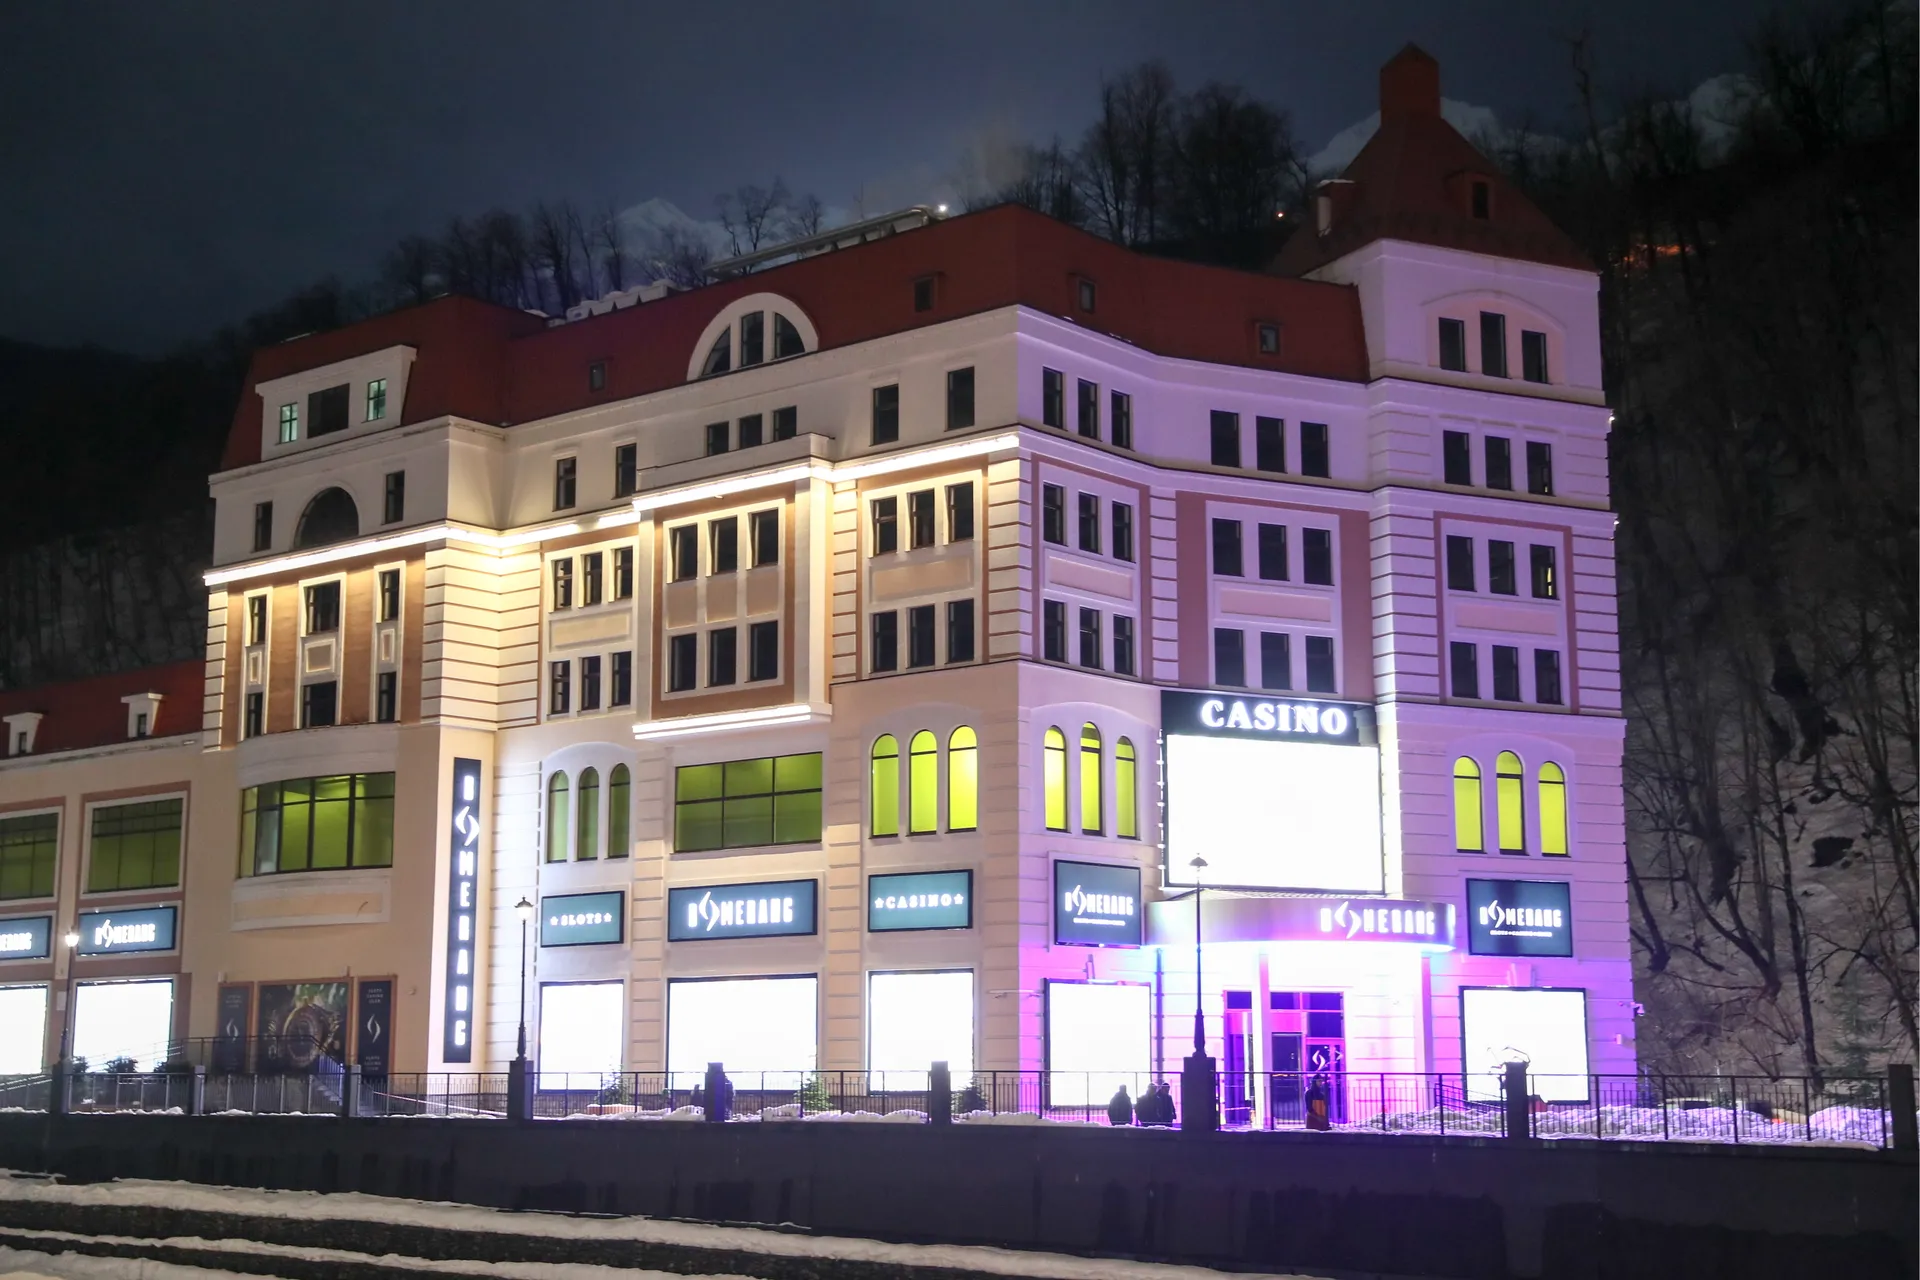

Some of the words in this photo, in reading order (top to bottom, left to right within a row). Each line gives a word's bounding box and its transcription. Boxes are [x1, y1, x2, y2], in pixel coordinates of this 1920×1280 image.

[1201, 700, 1348, 735] CASINO
[885, 893, 952, 909] CASINO
[561, 912, 602, 926] SLOTS
